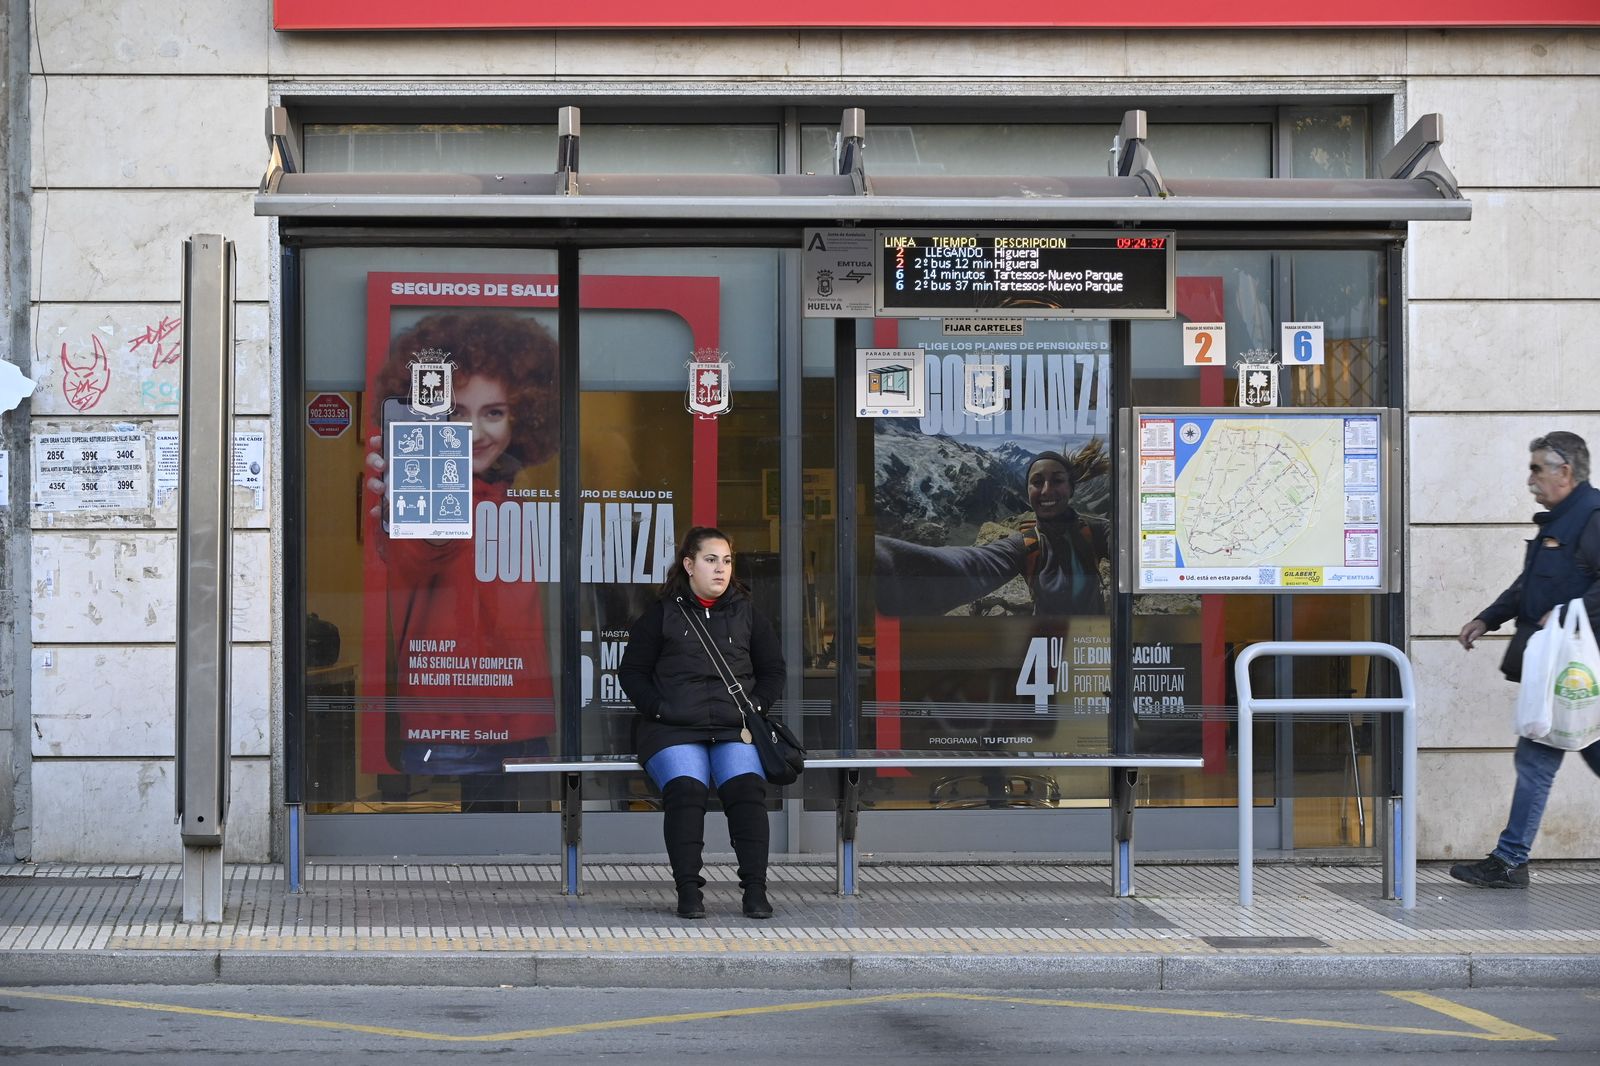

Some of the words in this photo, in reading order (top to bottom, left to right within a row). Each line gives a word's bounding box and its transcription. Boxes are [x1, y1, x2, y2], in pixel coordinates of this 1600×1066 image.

[884, 237, 916, 248] LINEA
[932, 237, 976, 248] TIEMPO
[994, 238, 1066, 248] DESCRIPCION
[1117, 238, 1164, 248] 09:24:37
[896, 247, 904, 257] 2
[925, 247, 983, 257] LLEGANDO
[994, 248, 1039, 260] Higueral
[896, 259, 904, 268] 2
[931, 259, 951, 268] bus
[955, 259, 968, 268] 12
[973, 259, 992, 268] min
[994, 259, 1039, 271] Higueral
[896, 269, 904, 279] 6
[923, 269, 936, 279] 14
[941, 270, 985, 279] minutos
[1086, 270, 1123, 282] Parque
[391, 282, 480, 295] SEGUROS
[484, 284, 508, 296] DE
[511, 284, 558, 296] SALU
[896, 280, 904, 290] 6
[931, 280, 951, 290] bus
[955, 281, 968, 290] 37
[973, 281, 992, 290] min
[1086, 281, 1123, 293] Parque
[1195, 332, 1212, 363] 2
[1294, 331, 1312, 362] 6
[310, 409, 349, 418] 902.333.581
[47, 451, 64, 460] 285€
[82, 451, 98, 460] 399€
[117, 450, 134, 458] 340€
[118, 481, 134, 489] 399€
[507, 489, 537, 497] ELIGE
[554, 490, 600, 498] SURO
[619, 490, 656, 499] SALUD
[475, 501, 676, 584] CONANZA
[409, 640, 437, 652] NUEVA
[439, 640, 456, 652] APP
[1074, 647, 1085, 664] DE
[1088, 642, 1171, 664] BONACIÓN
[409, 654, 427, 669] MÁS
[430, 657, 470, 669] SENCILLA
[472, 658, 477, 669] Y
[480, 657, 523, 670] COMPLETA
[409, 673, 420, 685] LA
[421, 673, 450, 686] MEJOR
[452, 674, 514, 686] TELEMEDICINA
[1074, 675, 1092, 692] POR
[1094, 674, 1146, 692] TRAAR
[1150, 675, 1159, 691] TU
[1161, 675, 1184, 692] PLAN
[1162, 696, 1185, 714] PPA
[408, 729, 470, 739] MAPFRE
[474, 730, 508, 740] Salud
